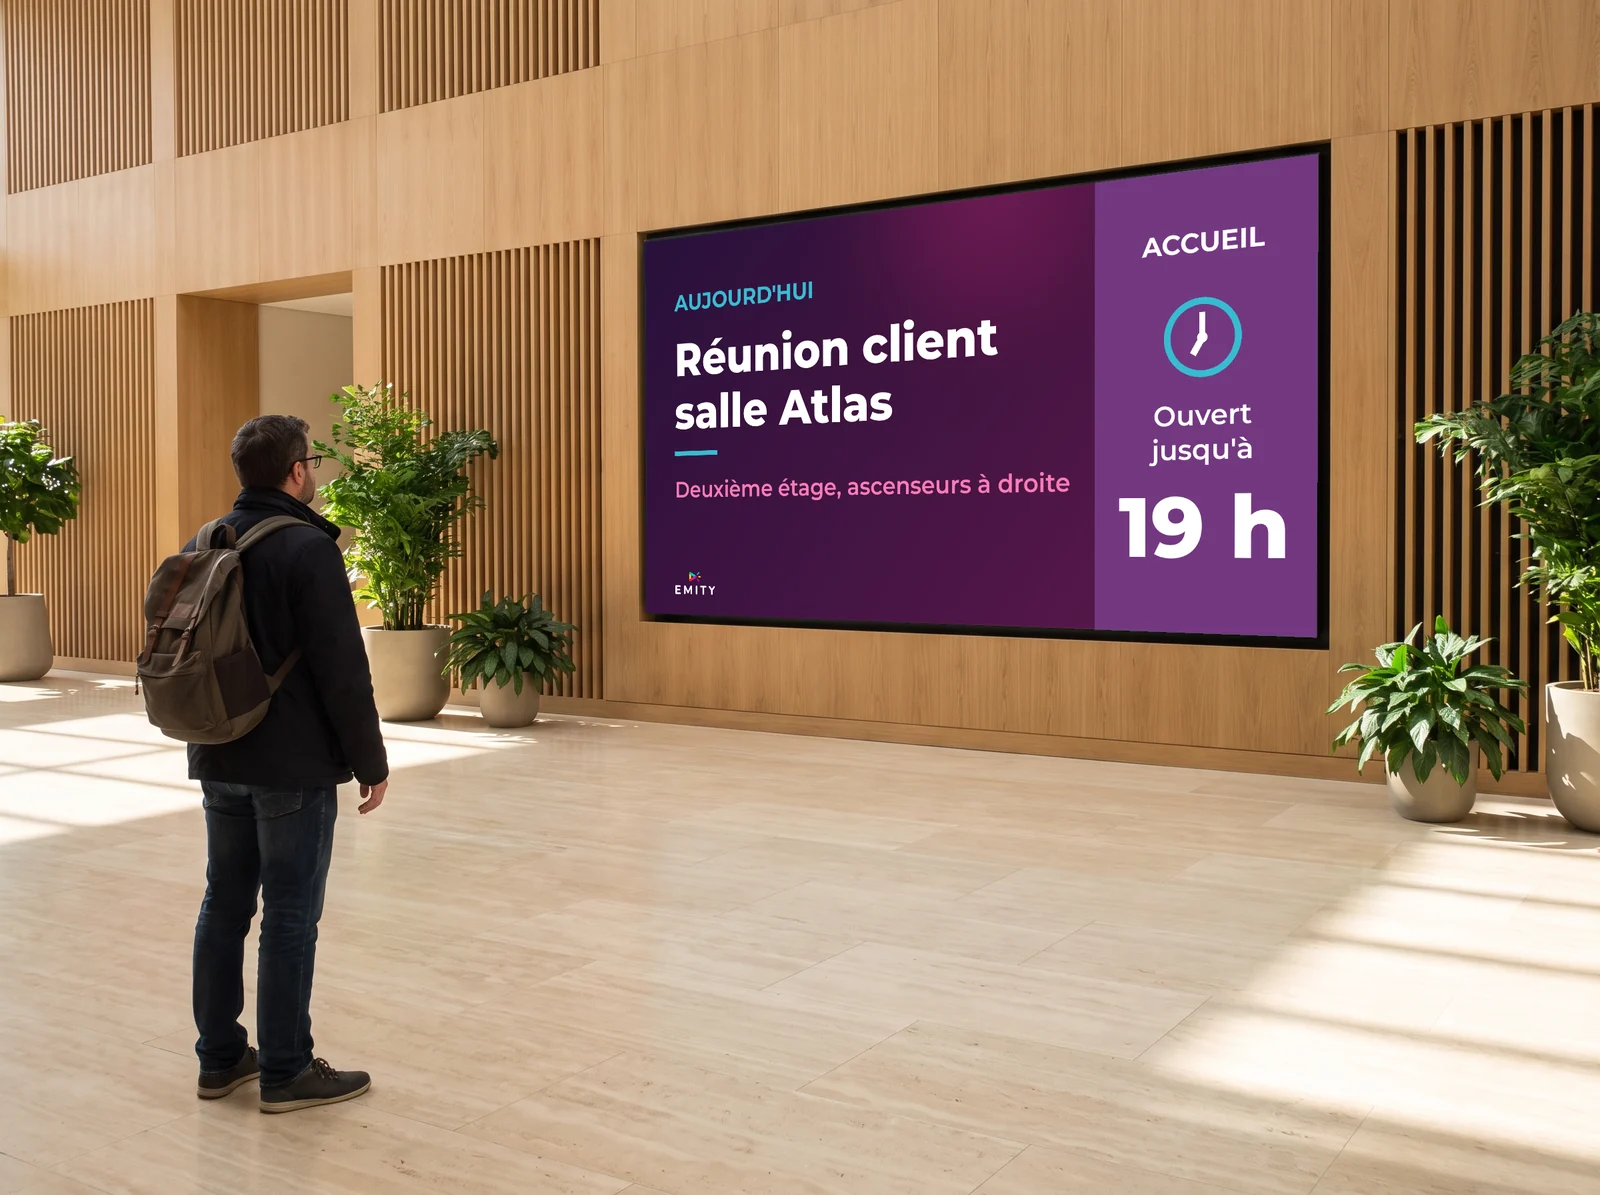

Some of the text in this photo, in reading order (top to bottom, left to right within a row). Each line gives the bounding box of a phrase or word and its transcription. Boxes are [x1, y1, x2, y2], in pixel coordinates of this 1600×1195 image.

[1142, 227, 1265, 258] ACCUEIL
[674, 281, 812, 312] AUJOURD'HUI
[676, 319, 999, 377] Réunion client
[675, 385, 893, 430] salle Atlas
[1153, 404, 1252, 427] Ouvert
[1149, 437, 1253, 467] jusqu'à
[676, 472, 1070, 501] Deuxième étage, ascenseurs à droite
[1119, 492, 1286, 559] 19 h
[674, 584, 716, 596] EMITY
